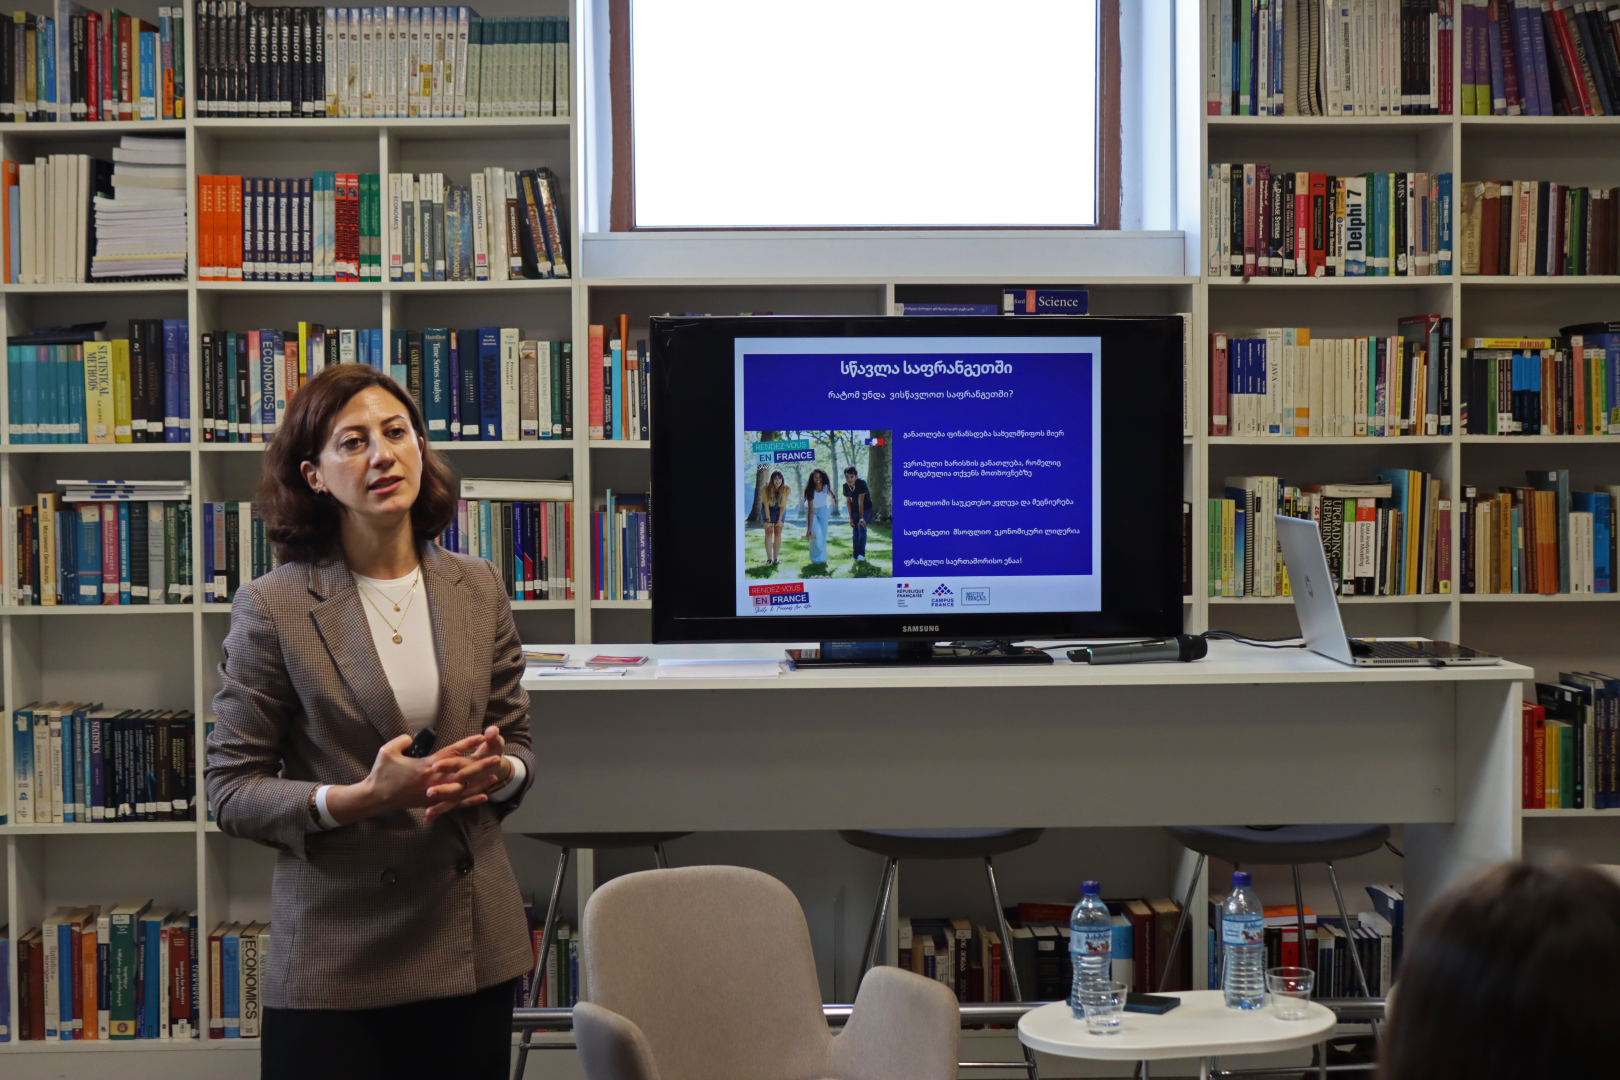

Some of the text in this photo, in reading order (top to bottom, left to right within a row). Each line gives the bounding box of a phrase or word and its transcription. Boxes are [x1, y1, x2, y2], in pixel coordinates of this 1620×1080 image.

[1347, 190, 1365, 250] Delphi 7
[336, 200, 346, 260] MICROECONOMICS
[348, 201, 358, 261] MICROECONOMICS
[1038, 296, 1078, 307] Science
[411, 350, 419, 365] GAME
[87, 352, 98, 391] METHODS
[97, 345, 109, 396] STATISTICAL
[262, 342, 274, 410] ECONOMICS
[590, 337, 602, 412] ECONOMICS
[840, 359, 1012, 377] სწავლა საფრანგეთში
[432, 379, 441, 403] Analysis
[828, 389, 1014, 400] რატომ უნდა ვისწავლოთ საფრანგეთში?
[903, 430, 945, 439] განათლება
[947, 430, 992, 438] ფინანსდება
[993, 430, 1045, 438] სახელმწიფოს
[755, 442, 806, 451] RENDEZ-VOUS
[759, 451, 813, 462] EN FRANCE
[903, 460, 943, 468] ევროპული
[903, 470, 952, 478] მორგებულია
[953, 470, 979, 478] თქვენს
[951, 499, 991, 507] საუკეთესო
[1032, 498, 1074, 506] მეცნიერება
[904, 528, 950, 537] საფრანგეთი
[1323, 500, 1332, 550] REPAIRING
[1332, 500, 1341, 558] UPGRADING
[904, 558, 944, 566] ფრანგული
[946, 557, 1002, 565] საერთაშორისო
[752, 585, 801, 594] RENDEZ-VOUS
[772, 594, 806, 604] FRANCE
[92, 721, 100, 754] STATISTICS
[245, 940, 256, 1019] ECONOMICS
